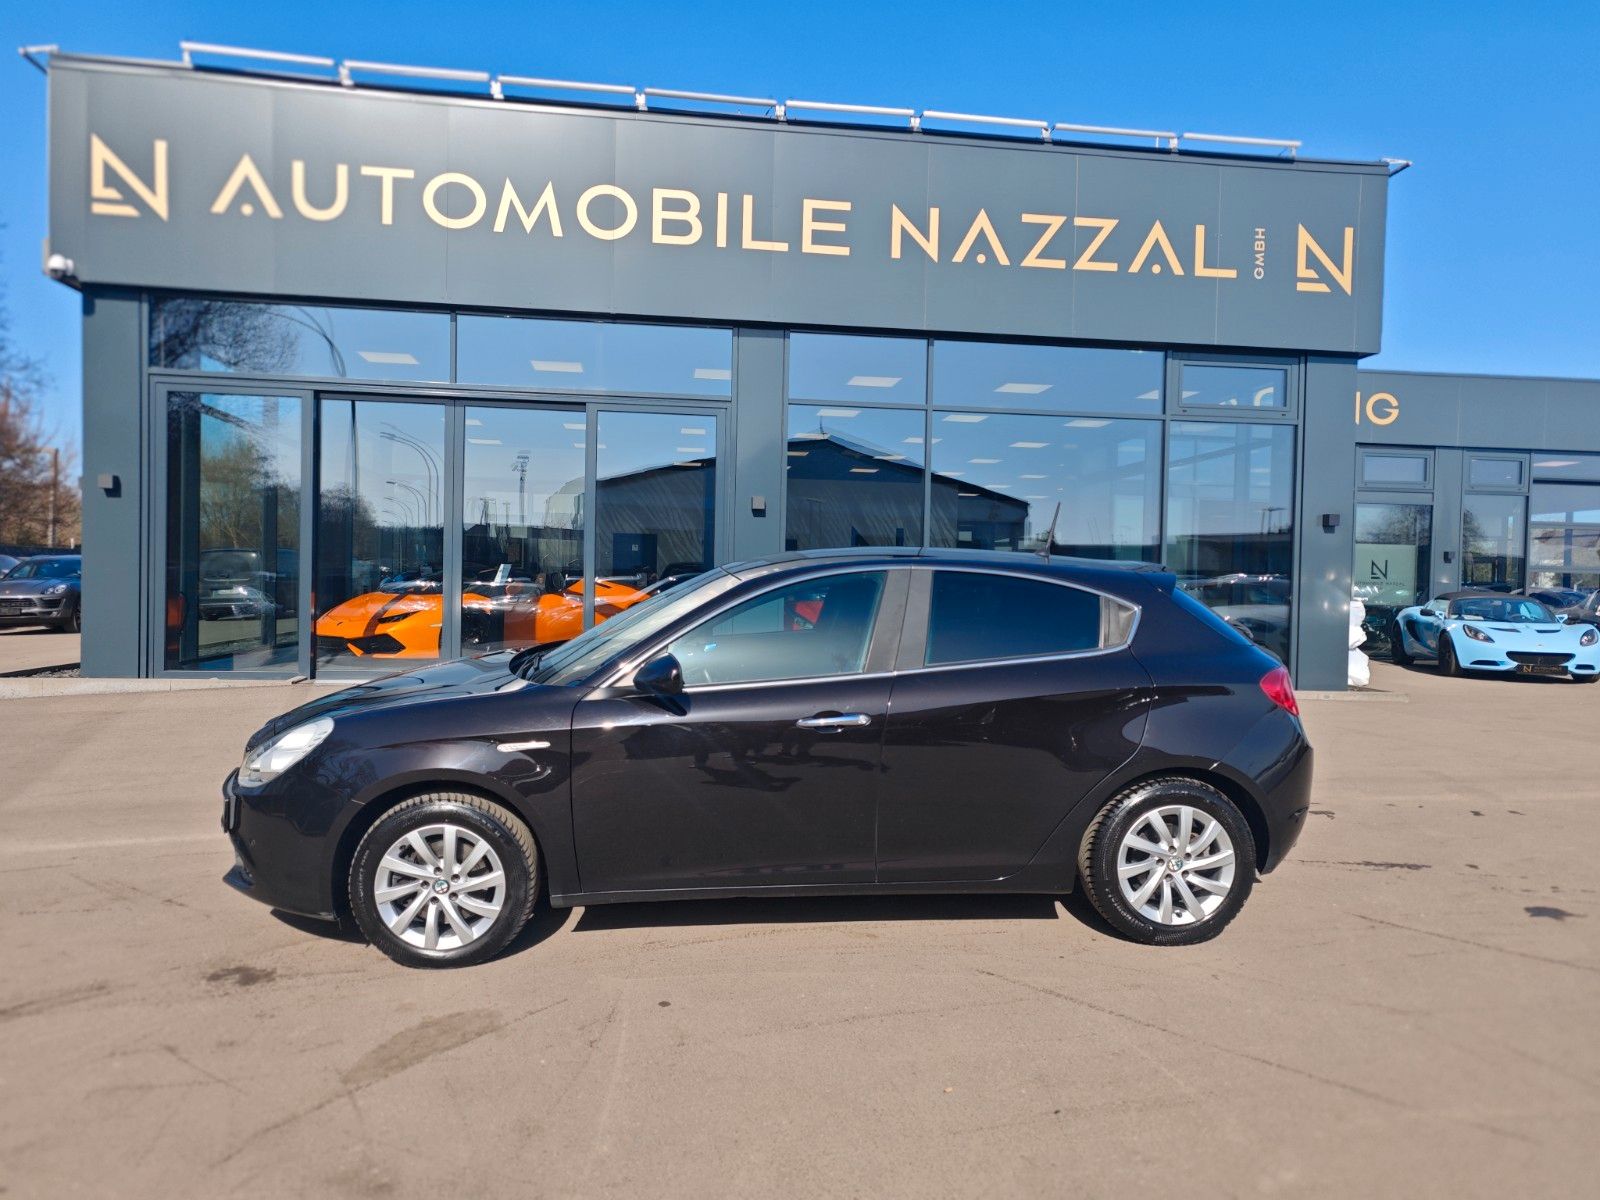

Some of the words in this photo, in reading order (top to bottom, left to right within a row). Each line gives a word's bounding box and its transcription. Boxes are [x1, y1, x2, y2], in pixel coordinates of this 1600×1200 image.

[210, 153, 852, 257] AUTOMOBILE
[891, 203, 1238, 279] NAZZAL
[1253, 227, 1266, 281] GMBH
